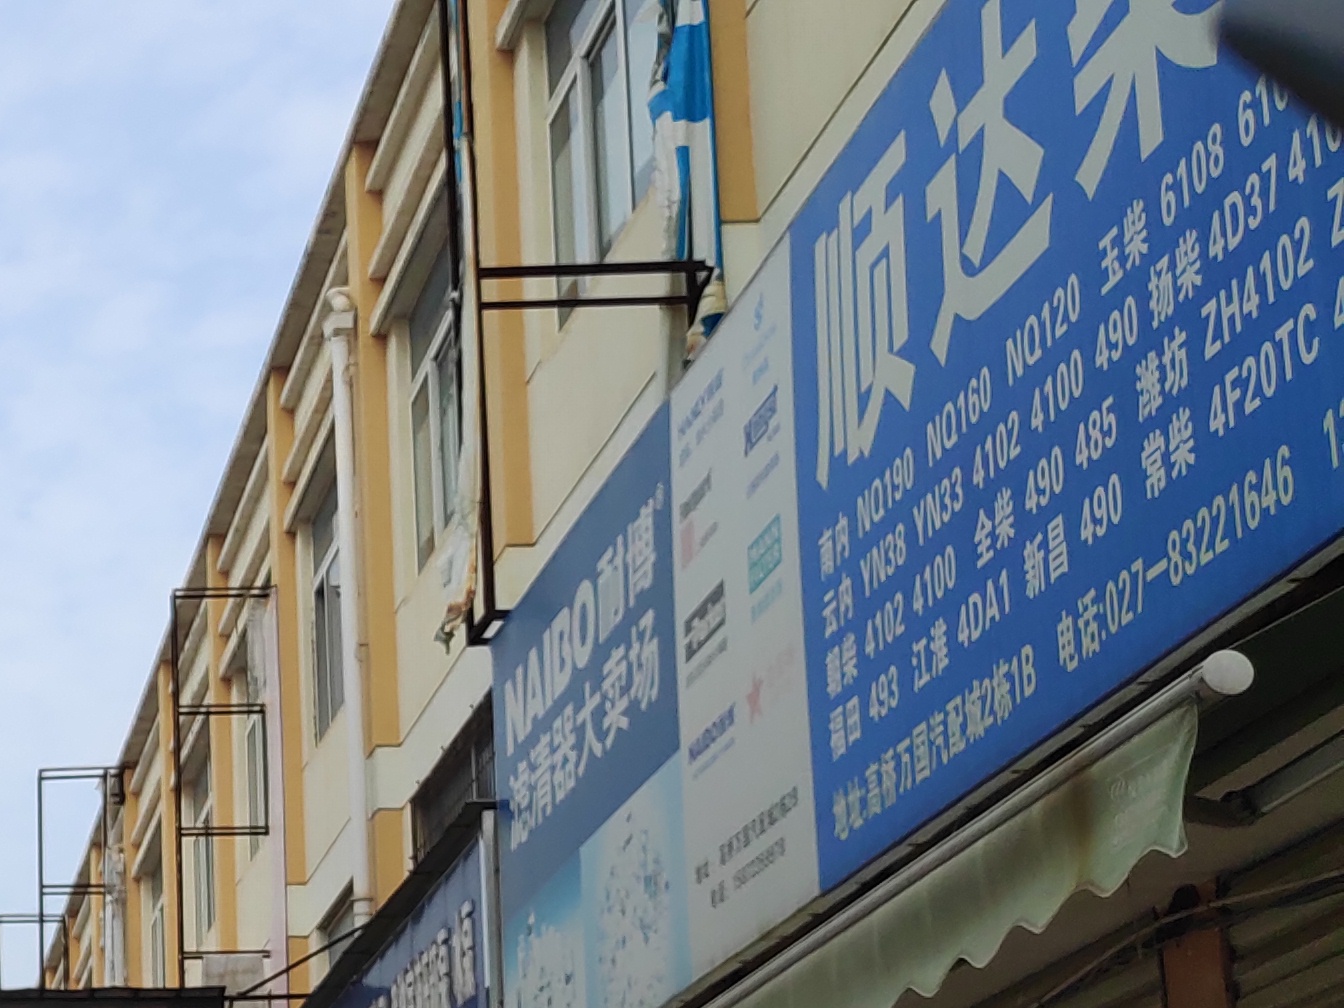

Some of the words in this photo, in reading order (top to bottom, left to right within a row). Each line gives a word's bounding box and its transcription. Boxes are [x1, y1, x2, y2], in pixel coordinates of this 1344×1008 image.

[822, 570, 854, 640] 云内
[859, 522, 907, 599] YN38
[912, 465, 963, 548] YN33
[972, 410, 1022, 491] 4102
[1029, 347, 1084, 433] 4100
[1094, 295, 1140, 372] 490
[1147, 228, 1203, 331] 扬柴
[1207, 151, 1279, 264] 4D37
[856, 446, 914, 540] NQ190
[926, 366, 992, 468] NQ160
[1005, 272, 1081, 387] NQ120
[1098, 198, 1150, 297] 玉柴
[1160, 122, 1225, 227] 6108
[1237, 73, 1289, 147] 610
[863, 591, 906, 660] 4102
[912, 551, 957, 618] 4100
[974, 487, 1016, 570] 全柴
[1024, 445, 1065, 516] 490
[1075, 396, 1118, 472] 485
[1134, 325, 1189, 424] 潍坊
[1200, 215, 1316, 361] ZH4102
[868, 665, 899, 722] 493
[911, 617, 950, 694] 江淮
[956, 567, 1012, 650] 4DA1
[1023, 512, 1070, 600] 新昌
[1079, 473, 1124, 547] 490
[1139, 406, 1196, 501] 常柴
[1208, 302, 1320, 441] 4F20TC
